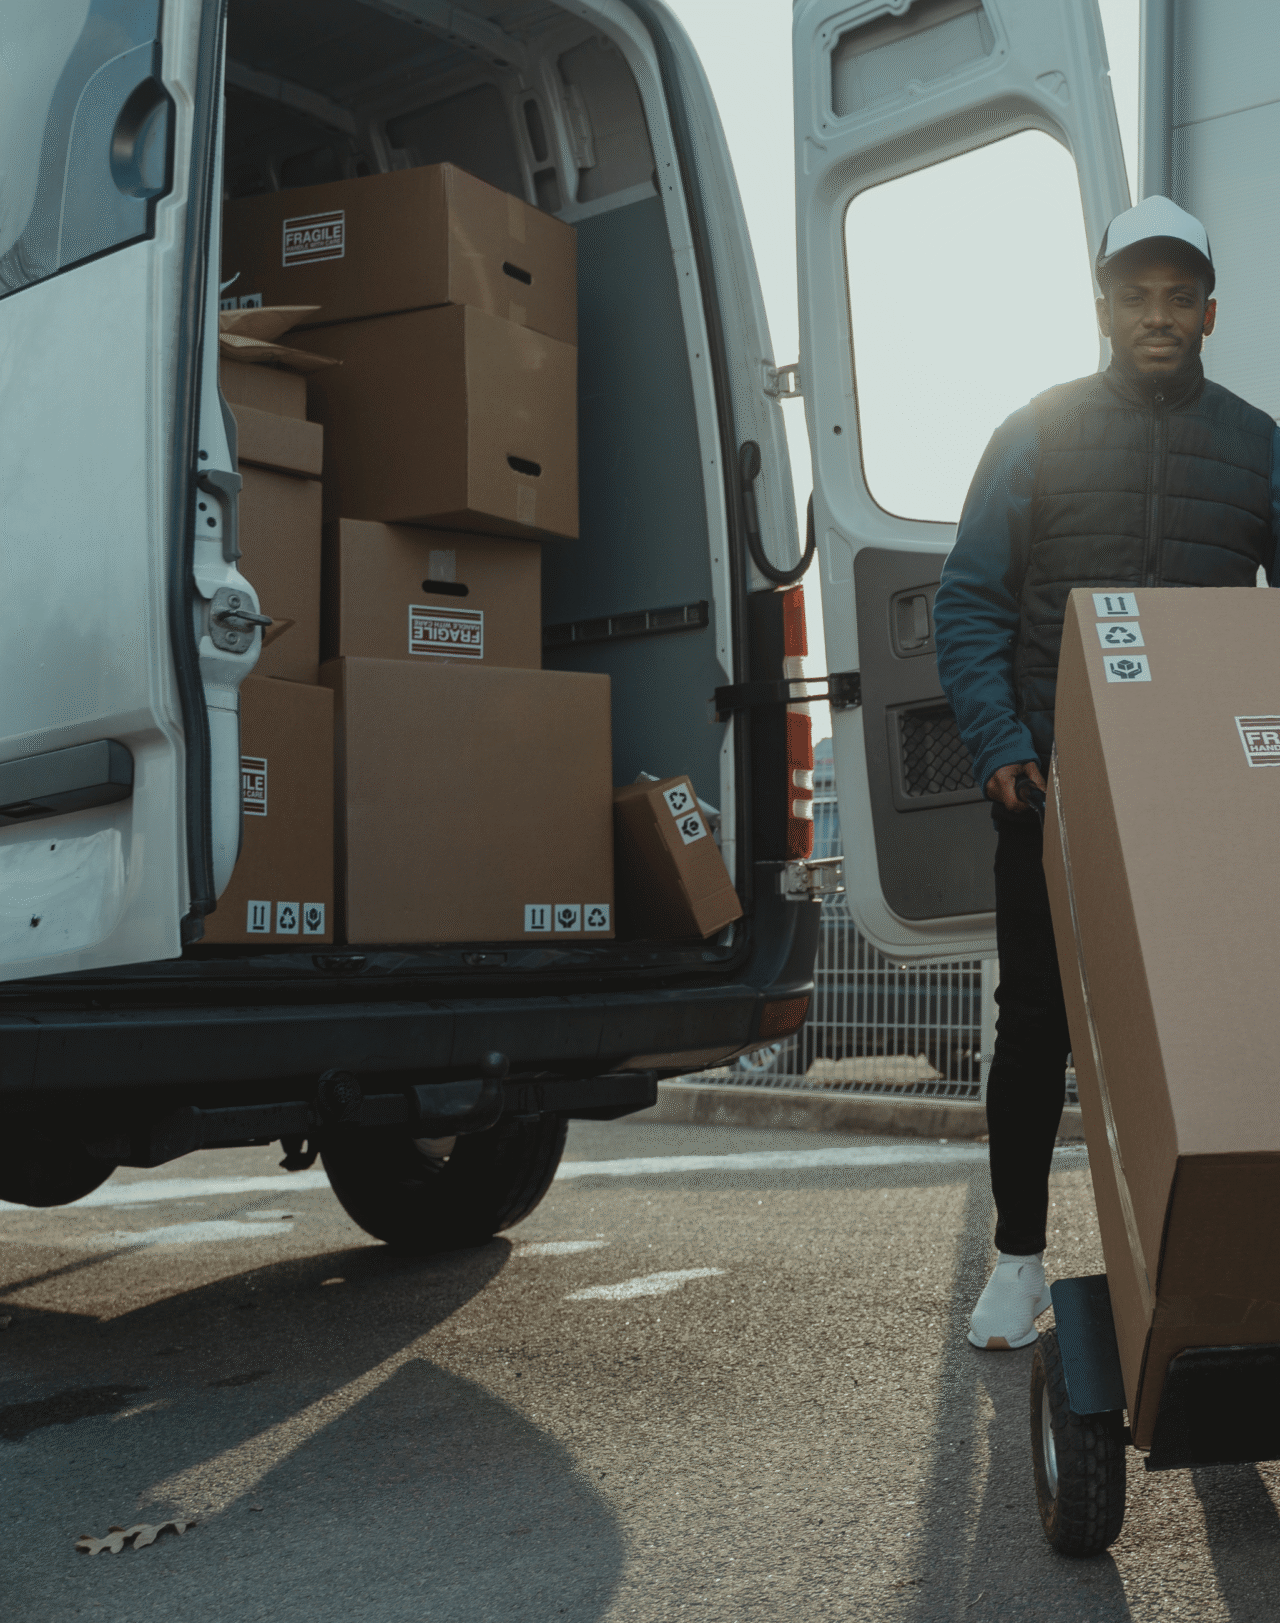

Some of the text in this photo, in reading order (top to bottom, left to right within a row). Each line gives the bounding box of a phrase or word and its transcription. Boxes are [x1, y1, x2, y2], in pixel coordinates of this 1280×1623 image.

[286, 225, 341, 246] FRAGILE
[413, 626, 480, 643] FRAGILE
[246, 790, 264, 799] CARE
